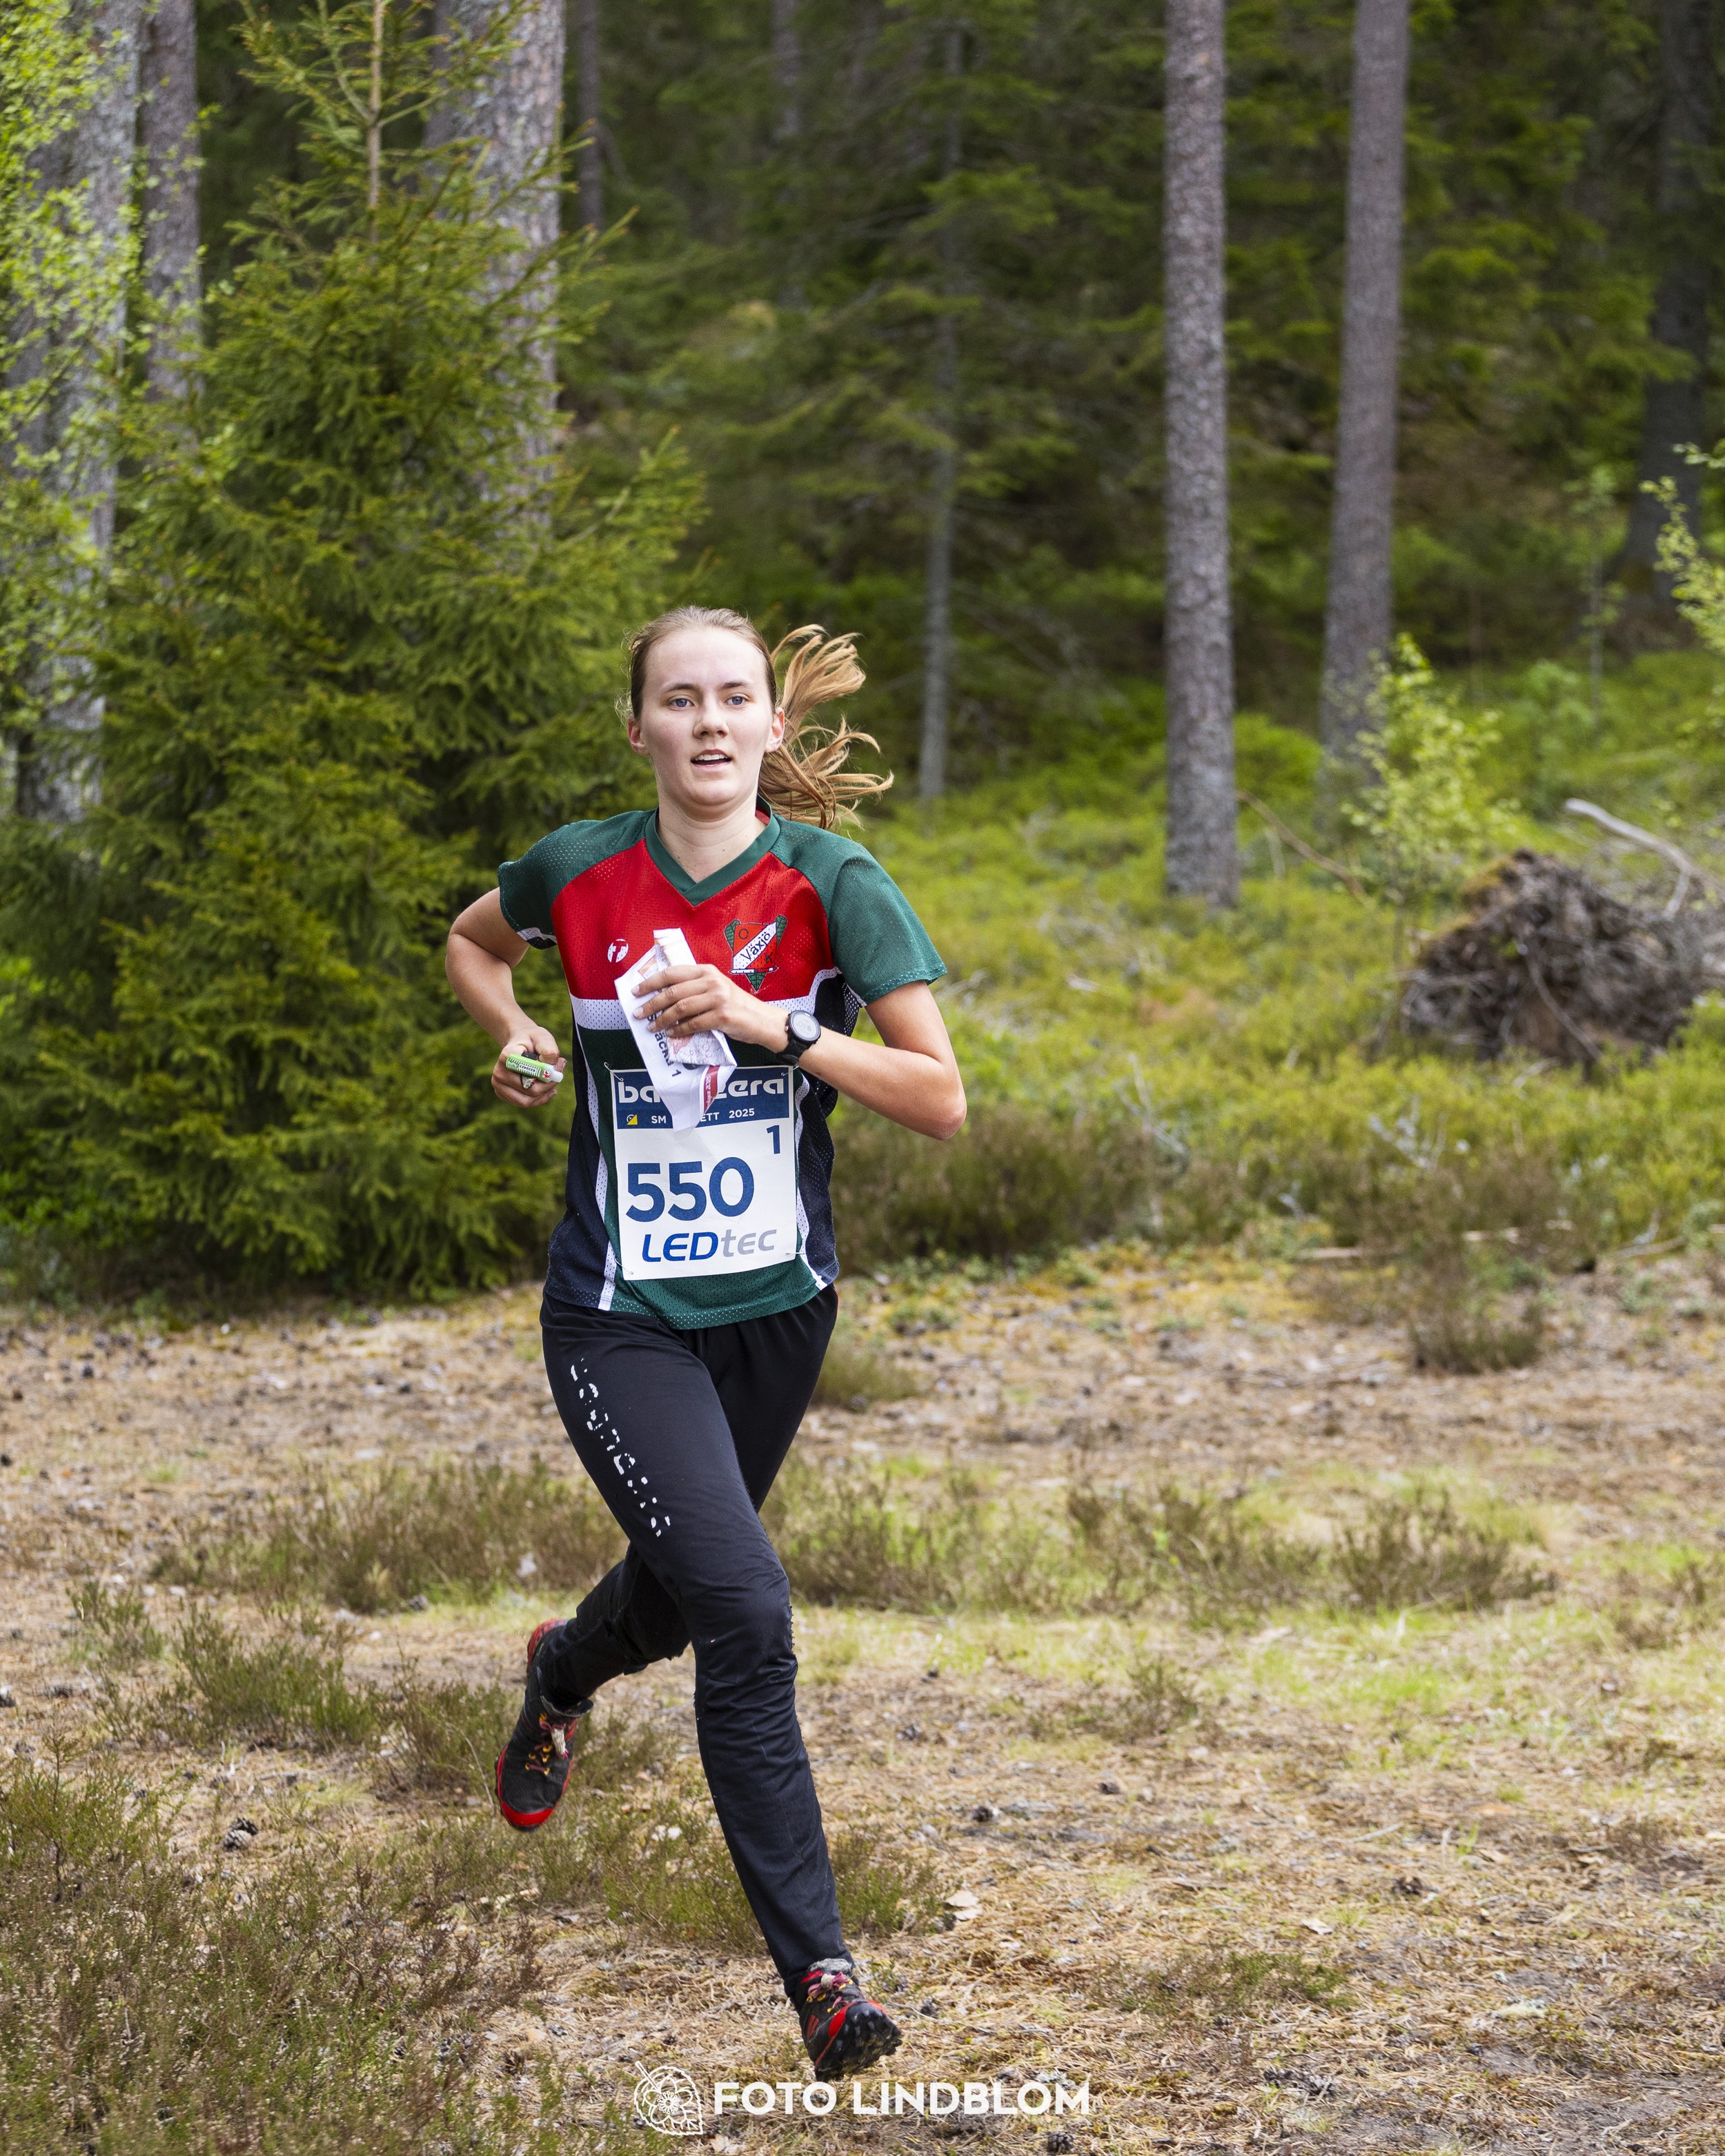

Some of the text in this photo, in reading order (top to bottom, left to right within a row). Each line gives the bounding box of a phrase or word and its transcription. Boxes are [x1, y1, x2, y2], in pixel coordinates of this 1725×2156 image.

[740, 931, 771, 960] Växjö
[651, 1115, 667, 1124] SM
[729, 1108, 755, 1119] 2025
[766, 1125, 780, 1155] 1
[625, 1156, 754, 1223] 550
[642, 1229, 777, 1263] LEDtec
